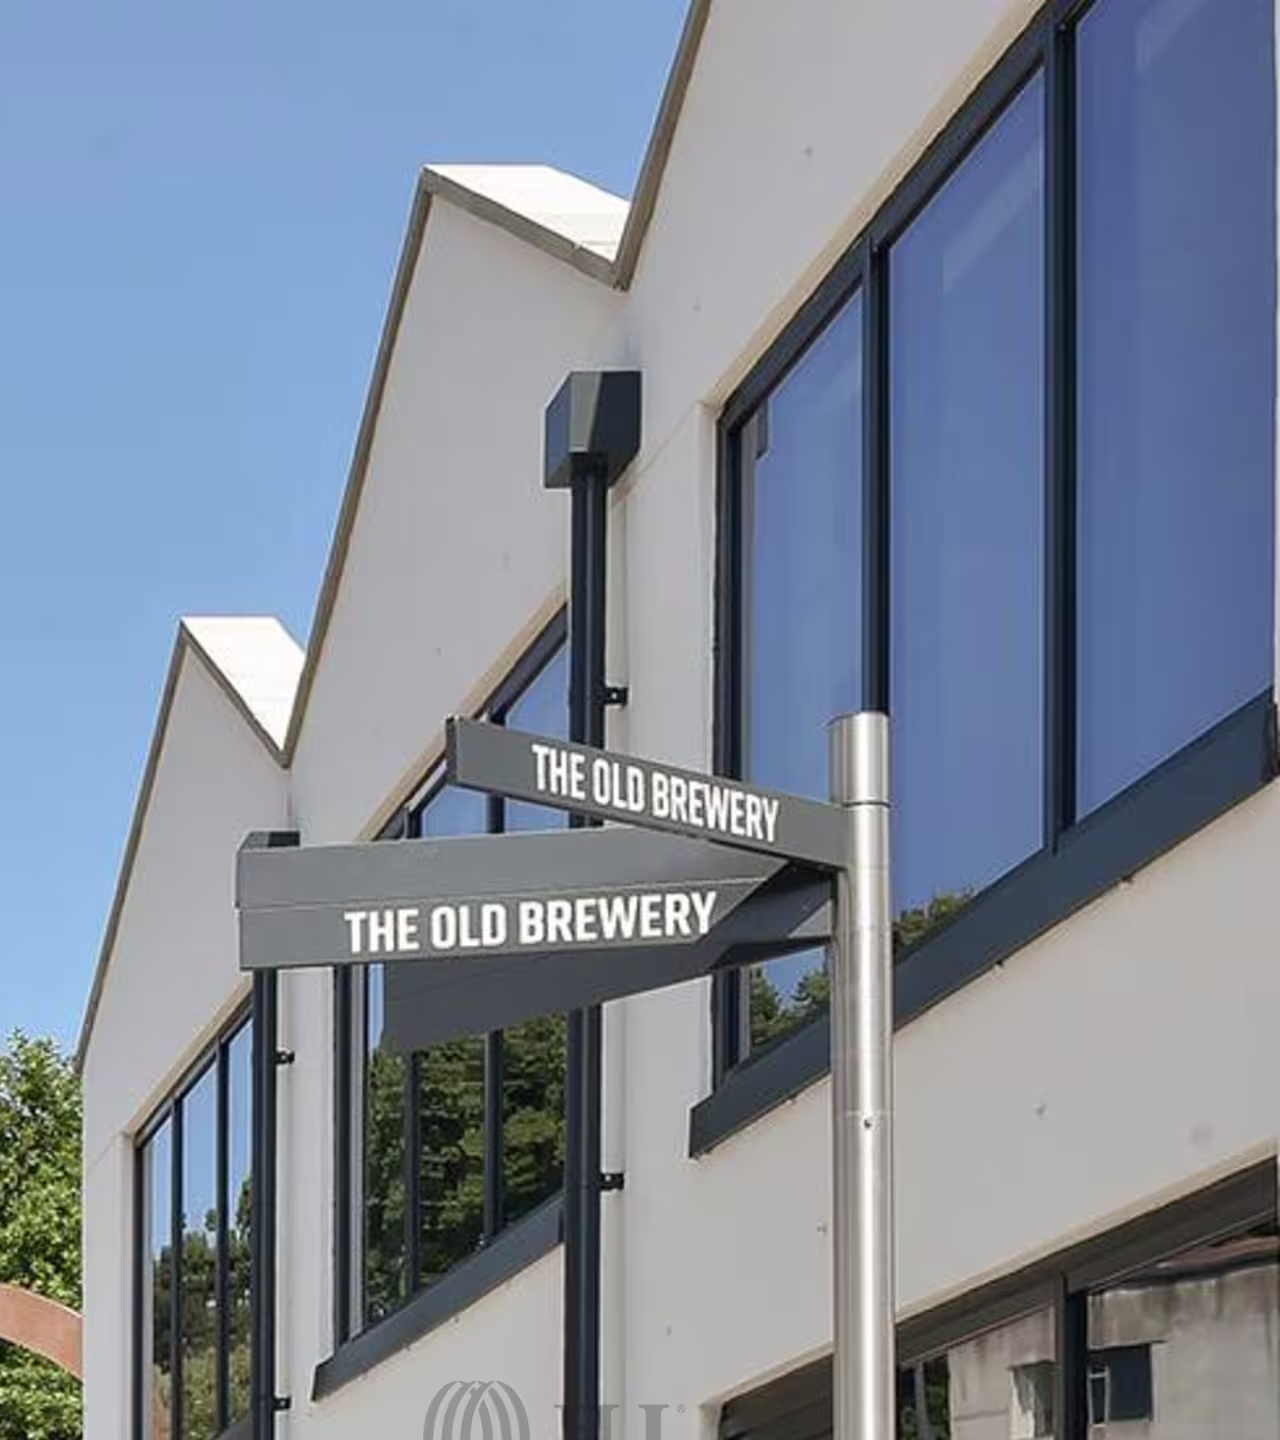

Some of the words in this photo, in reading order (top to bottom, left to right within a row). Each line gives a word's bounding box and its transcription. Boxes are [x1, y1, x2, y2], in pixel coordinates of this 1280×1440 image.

[532, 744, 586, 800] THE
[592, 758, 646, 812] OLD
[651, 772, 779, 842] BREWERY
[344, 908, 420, 953] THE
[430, 902, 507, 949] OLD
[519, 891, 718, 944] BREWERY
